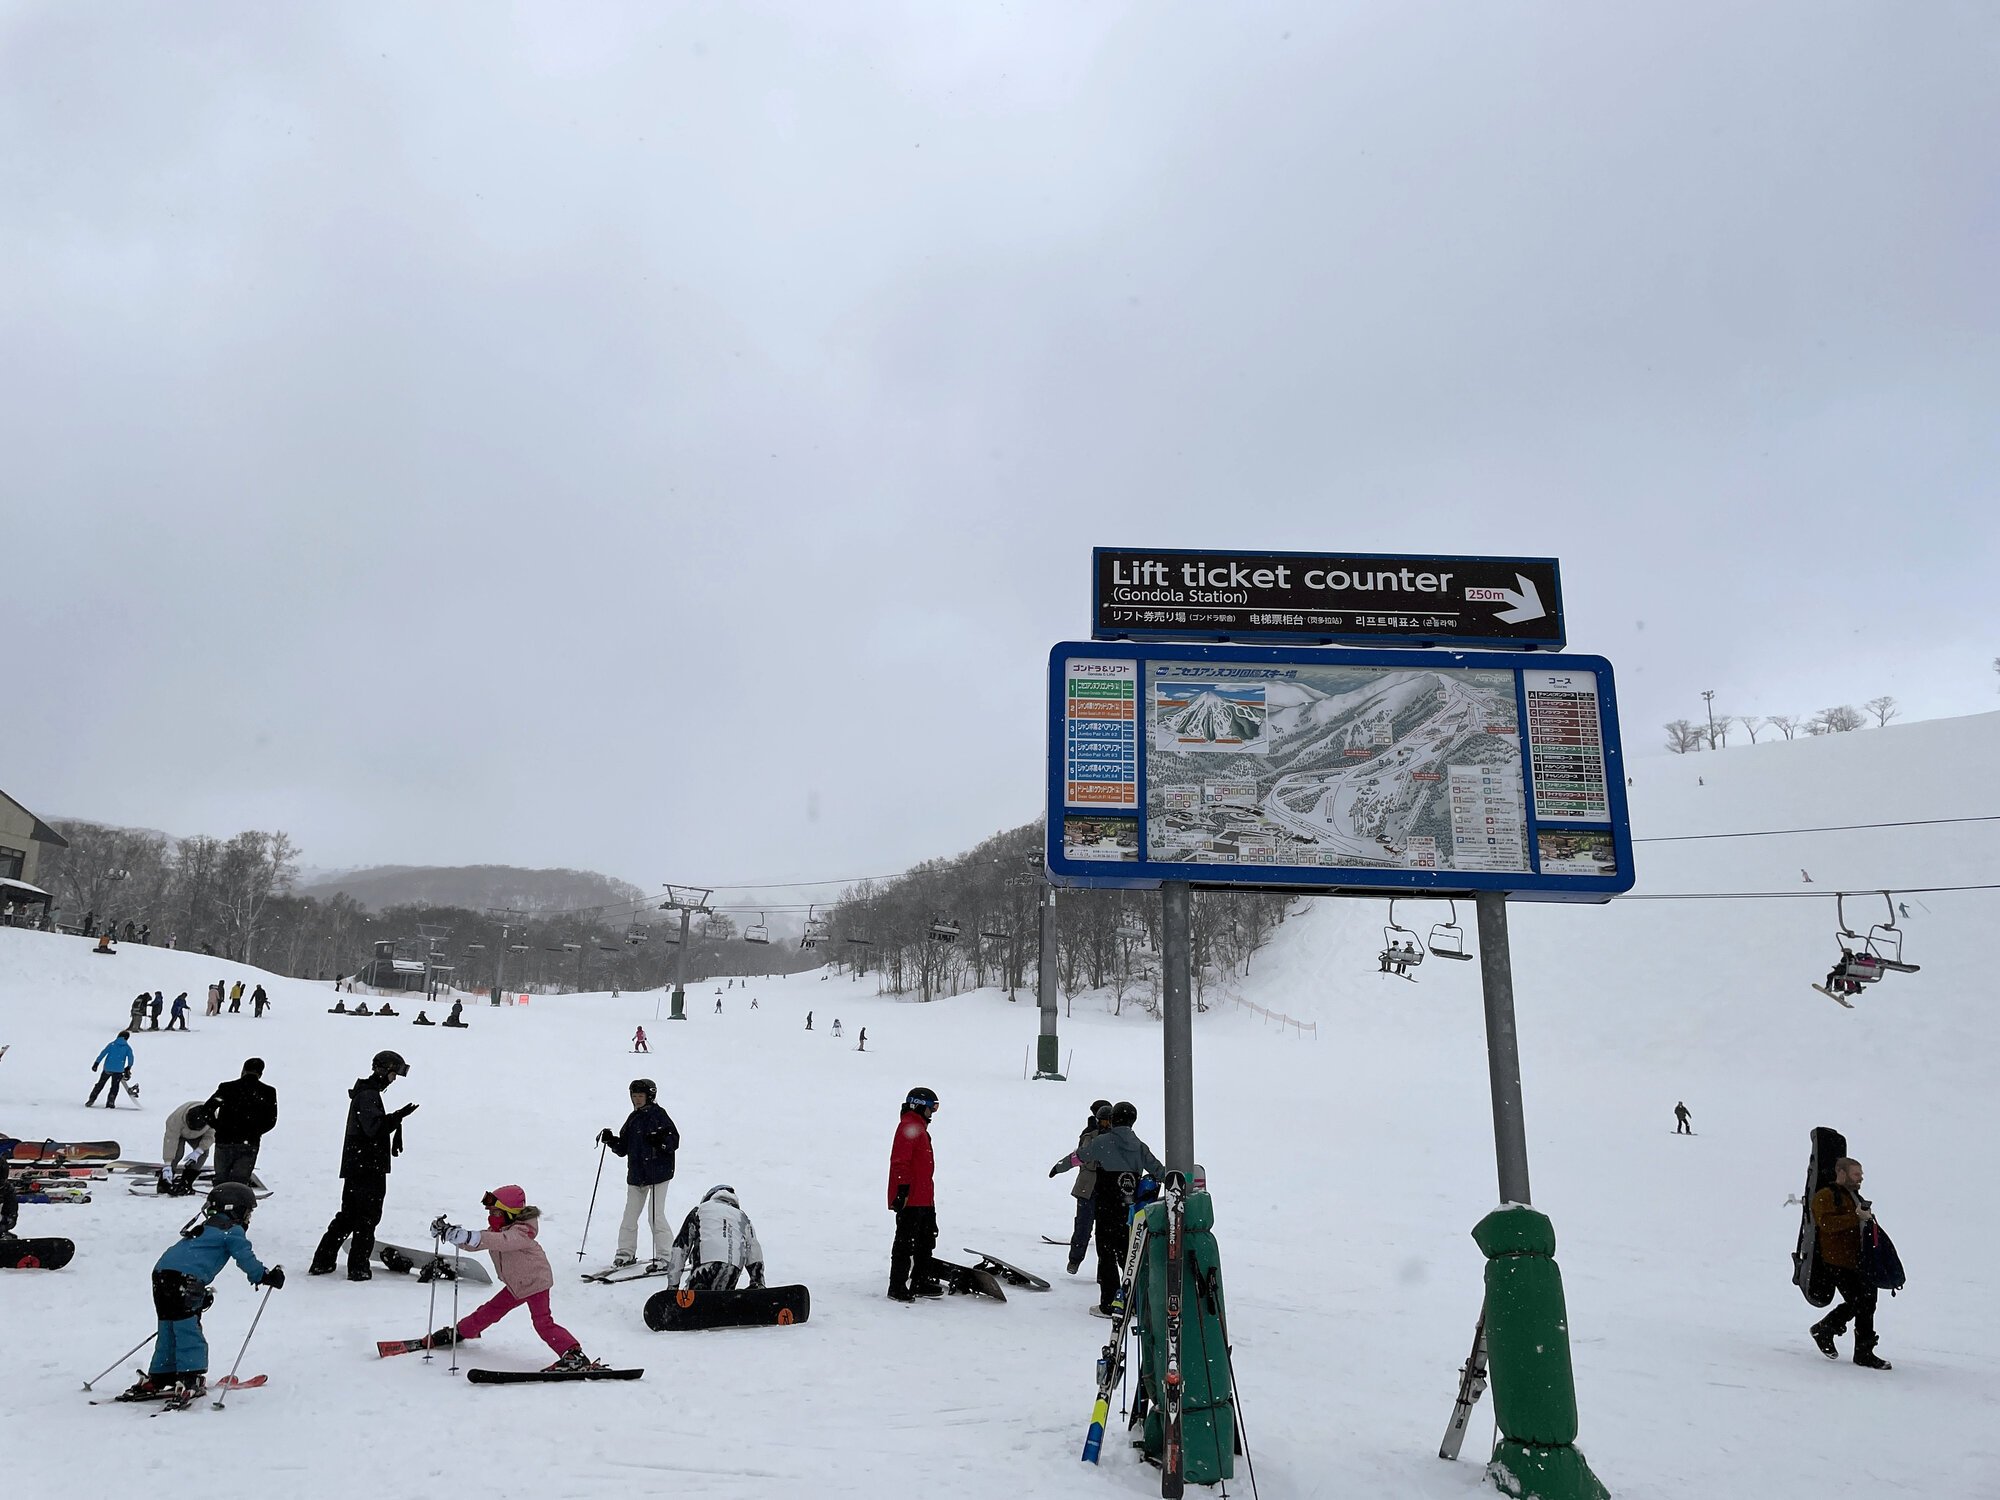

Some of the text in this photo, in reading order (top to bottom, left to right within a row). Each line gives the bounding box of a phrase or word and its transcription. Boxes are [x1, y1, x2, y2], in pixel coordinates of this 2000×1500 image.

[1113, 560, 1454, 592] Lift ticket counter
[1113, 587, 1248, 604] (Gondola Station)
[1468, 589, 1505, 601] 250m
[1113, 611, 1186, 623] リフト券売り場
[1355, 616, 1420, 627] 리프트매표소
[1126, 1222, 1144, 1277] DYNASTAR
